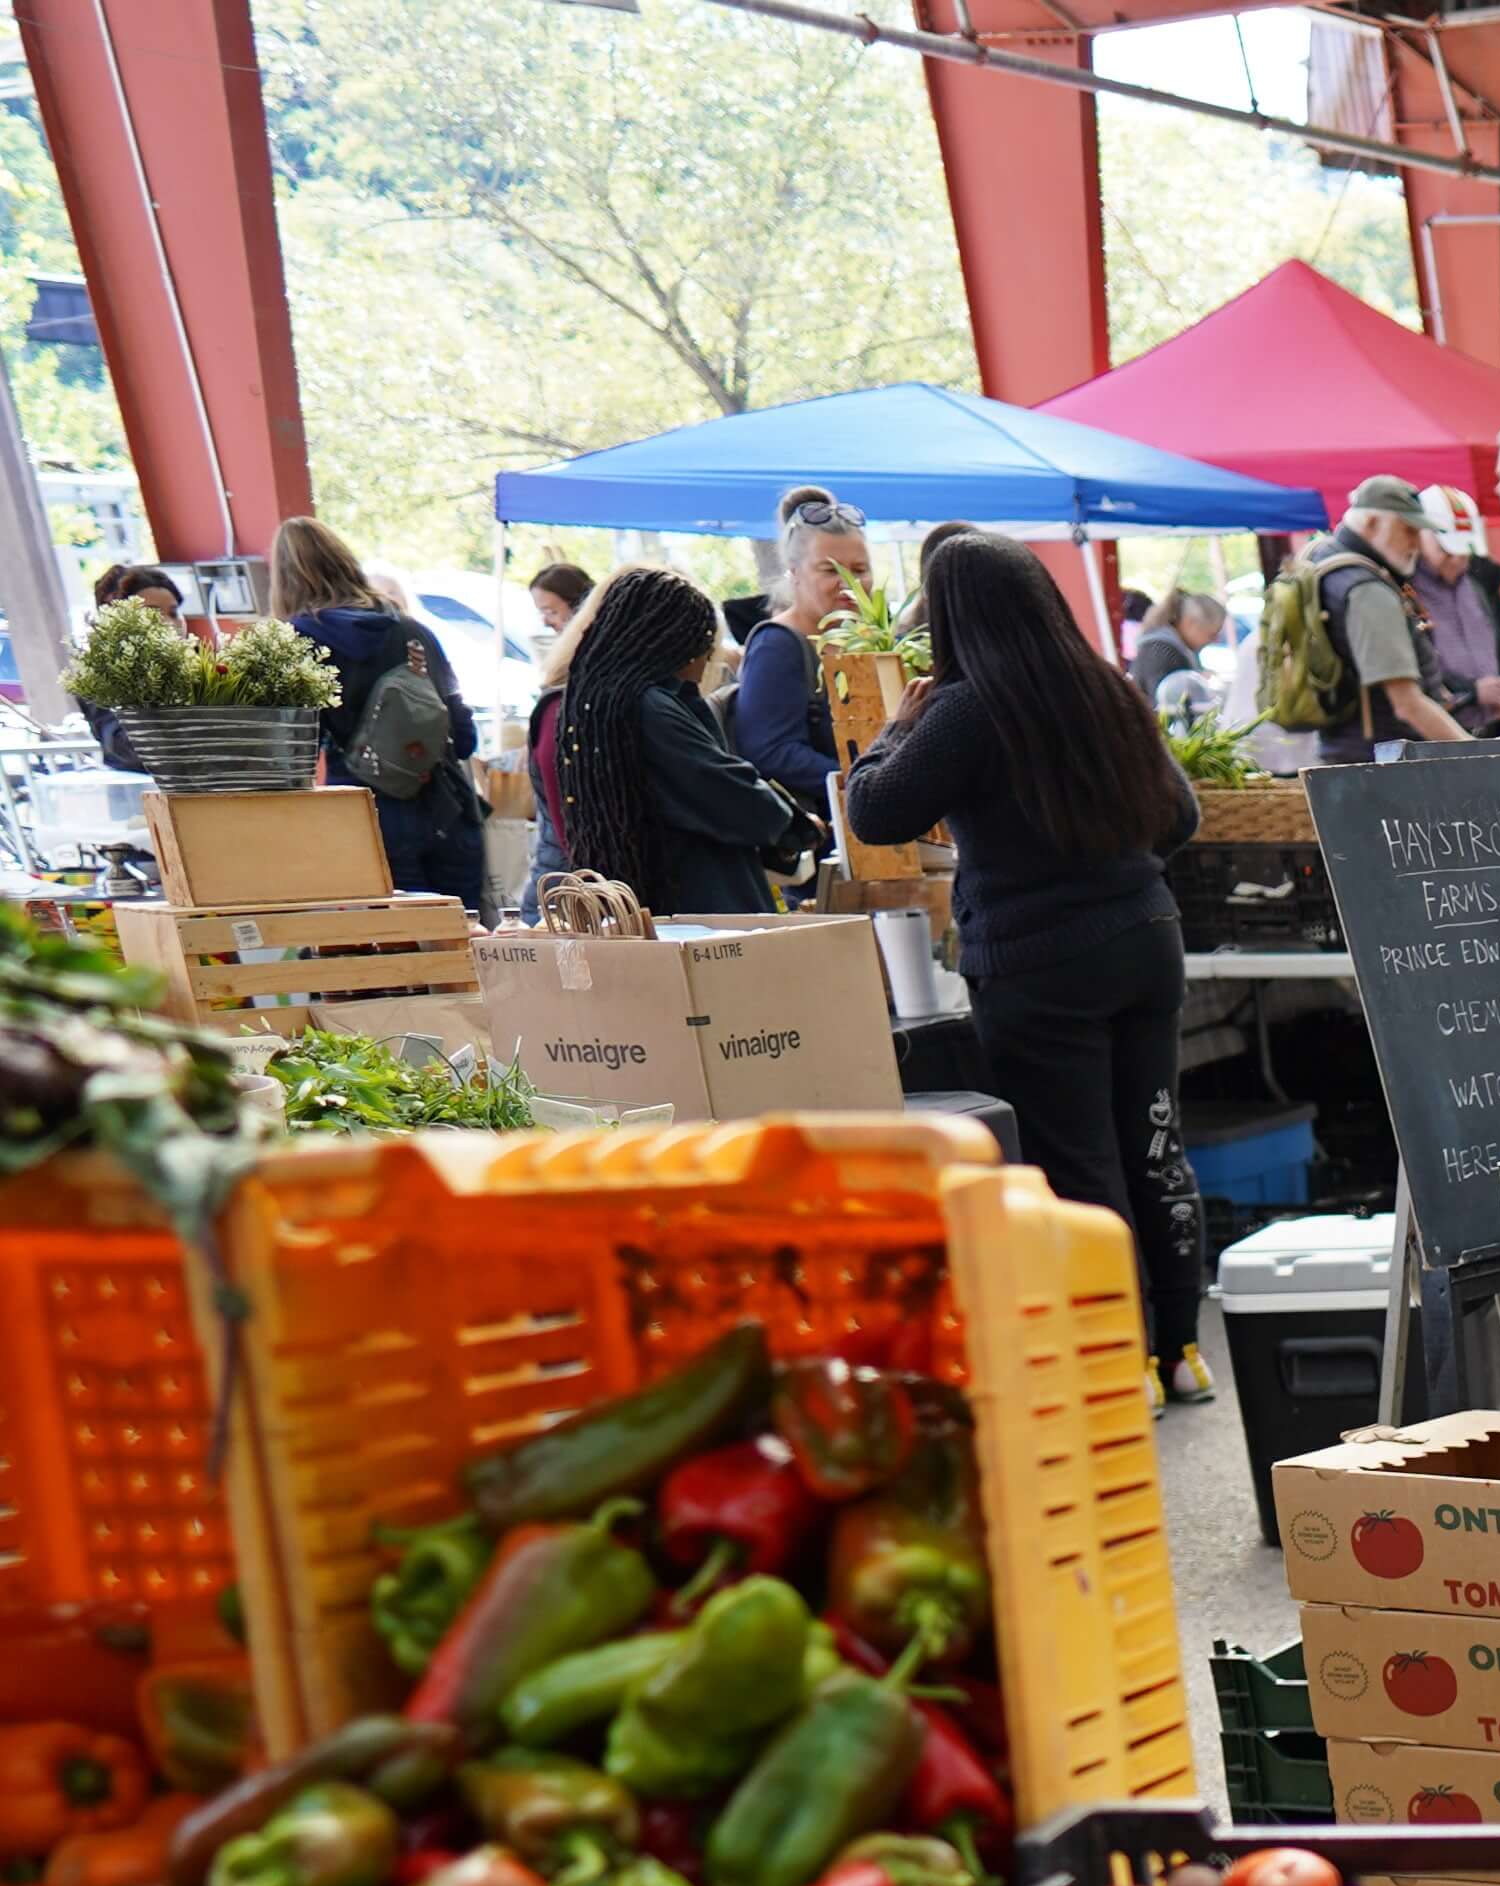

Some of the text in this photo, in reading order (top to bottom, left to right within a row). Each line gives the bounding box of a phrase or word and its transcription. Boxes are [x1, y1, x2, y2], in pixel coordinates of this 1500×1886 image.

[1422, 880, 1498, 921] FARMS
[480, 948, 537, 962] 6-4 LITRE
[693, 942, 743, 962] 6-4 LITRE
[1380, 943, 1450, 974] PRINCE
[545, 1037, 647, 1070] vinaigre
[719, 1028, 800, 1060] vinaigre
[1442, 1142, 1499, 1183] HERE
